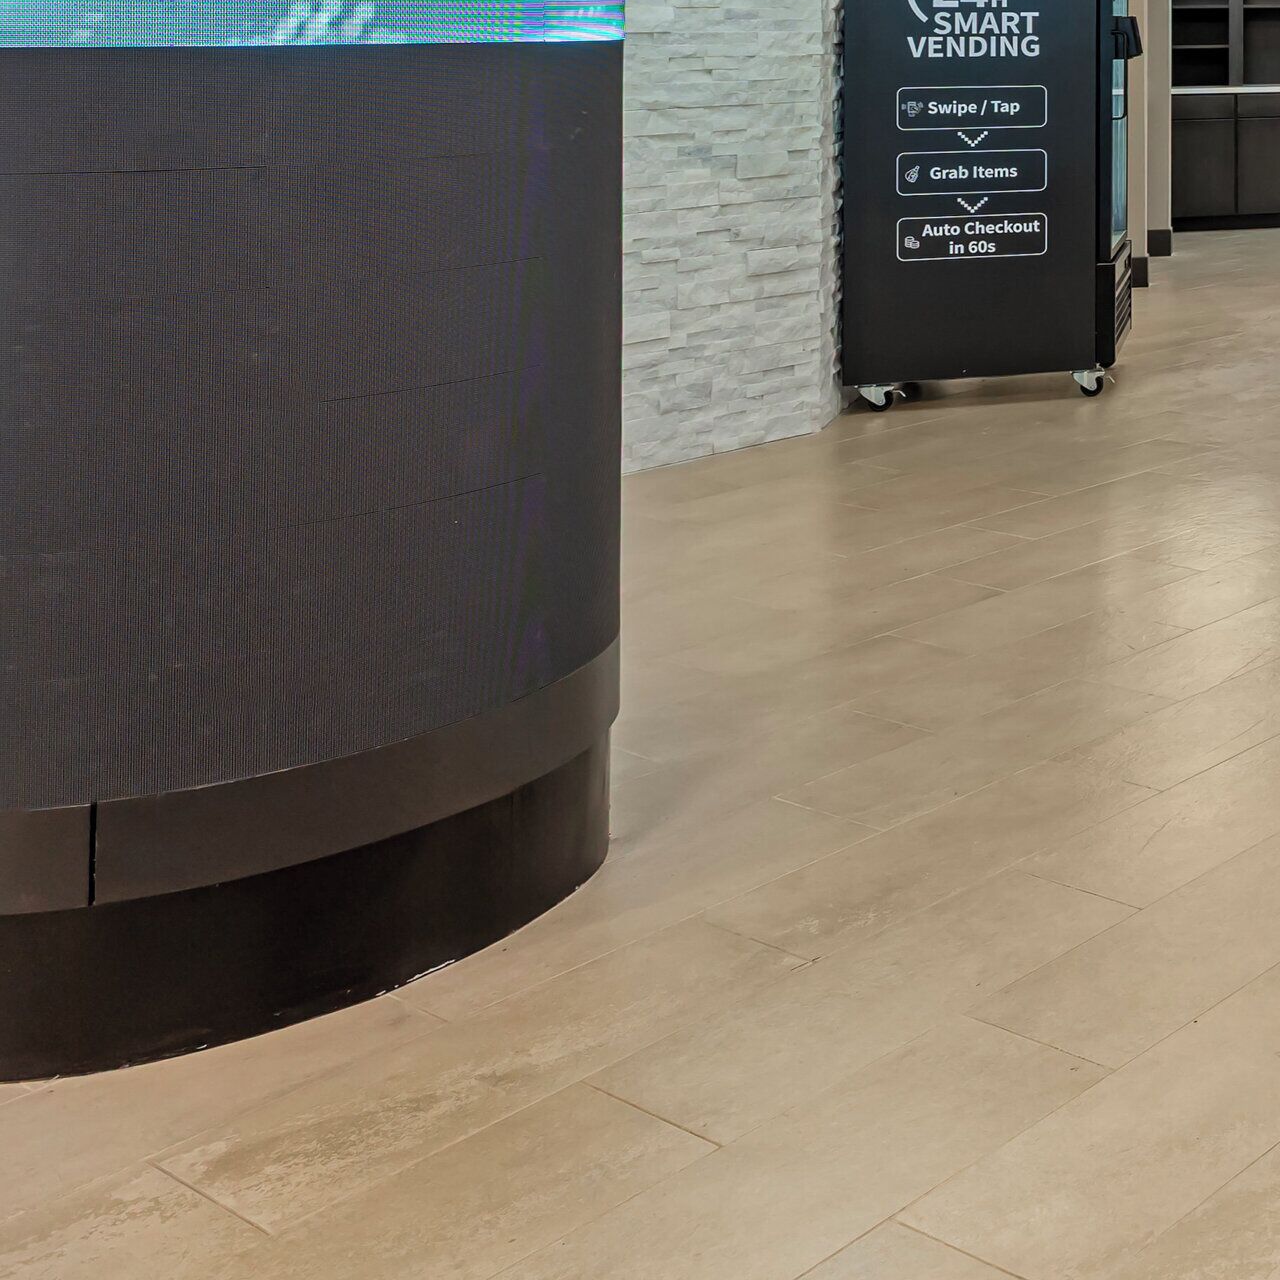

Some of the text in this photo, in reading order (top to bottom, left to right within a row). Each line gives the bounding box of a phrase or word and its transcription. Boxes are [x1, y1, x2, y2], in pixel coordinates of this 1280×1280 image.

[933, 11, 1040, 35] SMART
[907, 35, 1040, 58] VENDING
[927, 99, 1021, 117] Swipe / Tap
[929, 165, 1018, 180] Grab Items
[922, 220, 1041, 237] Auto Checkout
[949, 240, 996, 254] in 60s
